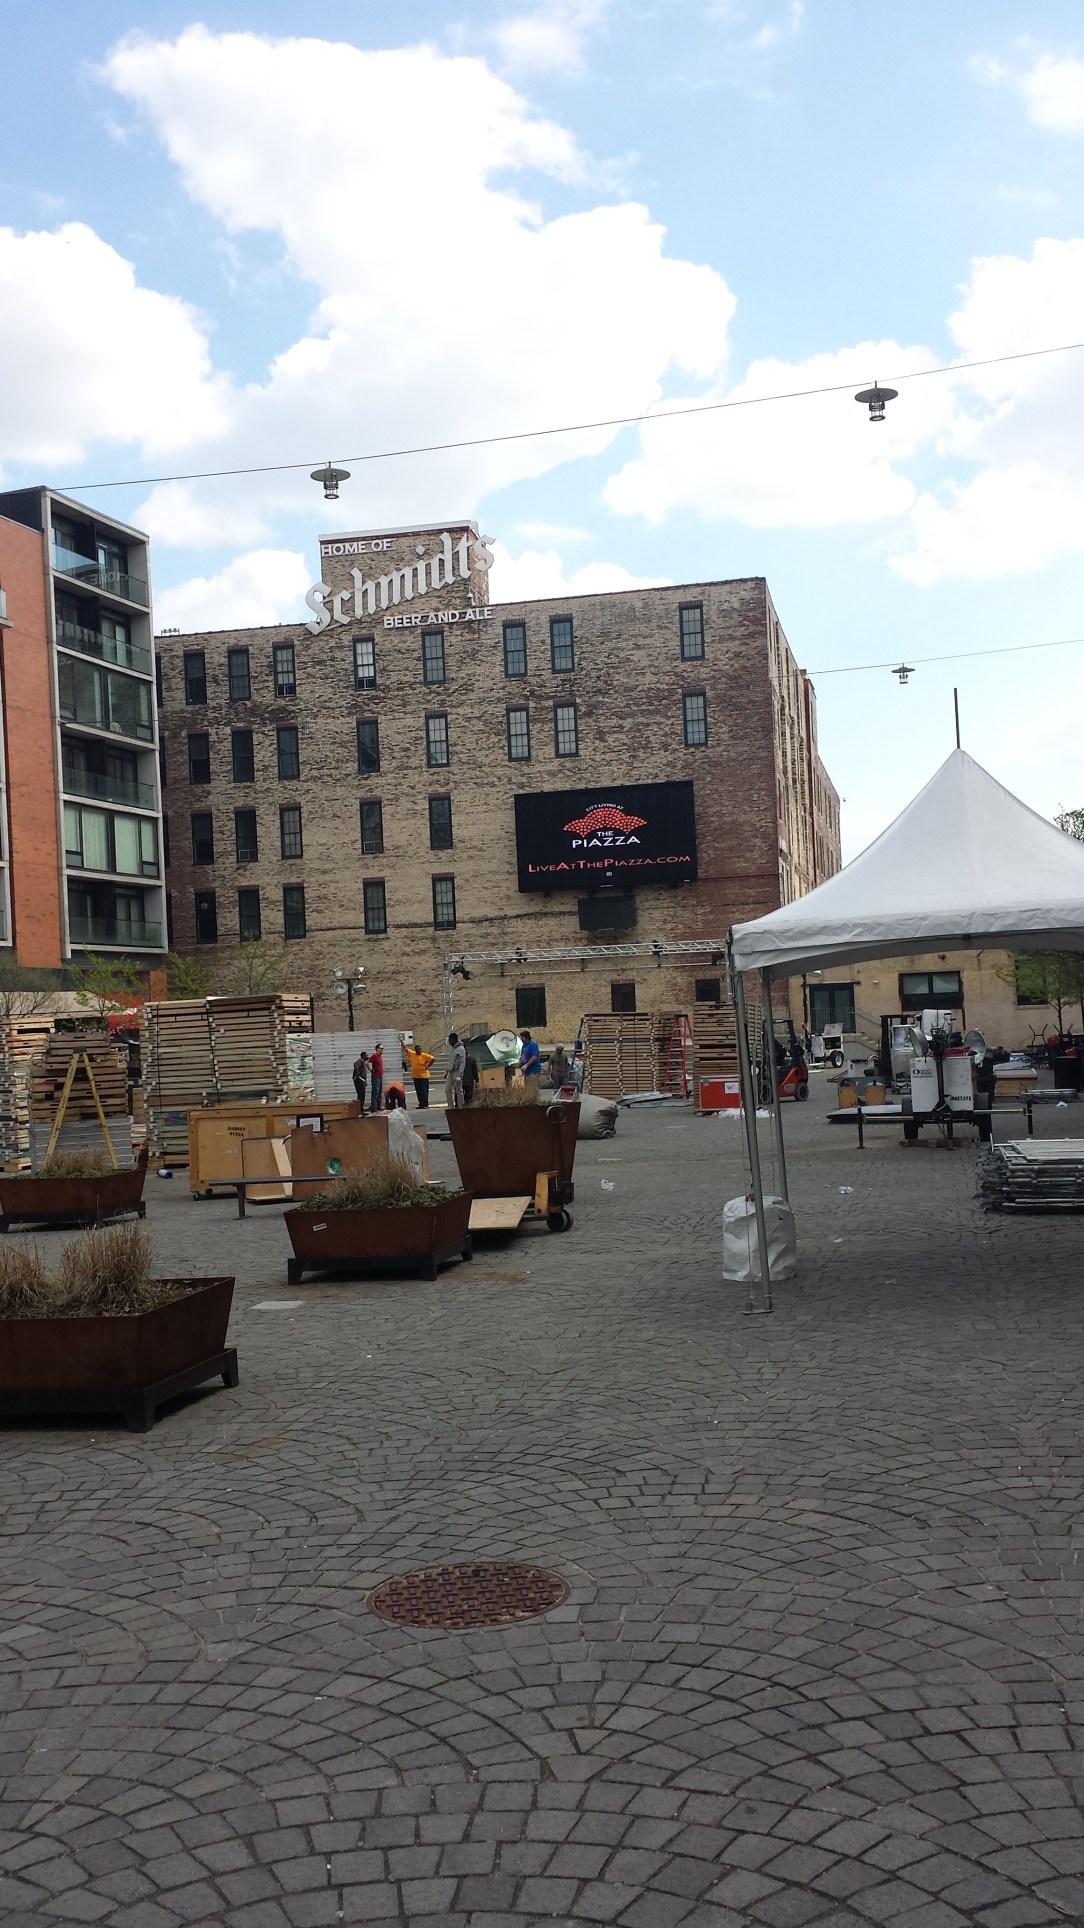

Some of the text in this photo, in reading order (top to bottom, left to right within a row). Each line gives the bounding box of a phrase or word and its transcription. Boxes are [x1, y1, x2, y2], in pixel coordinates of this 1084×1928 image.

[321, 538, 392, 557] HOME OF
[383, 606, 493, 629] BEER AND ALE
[572, 835, 641, 849] PIAZZA
